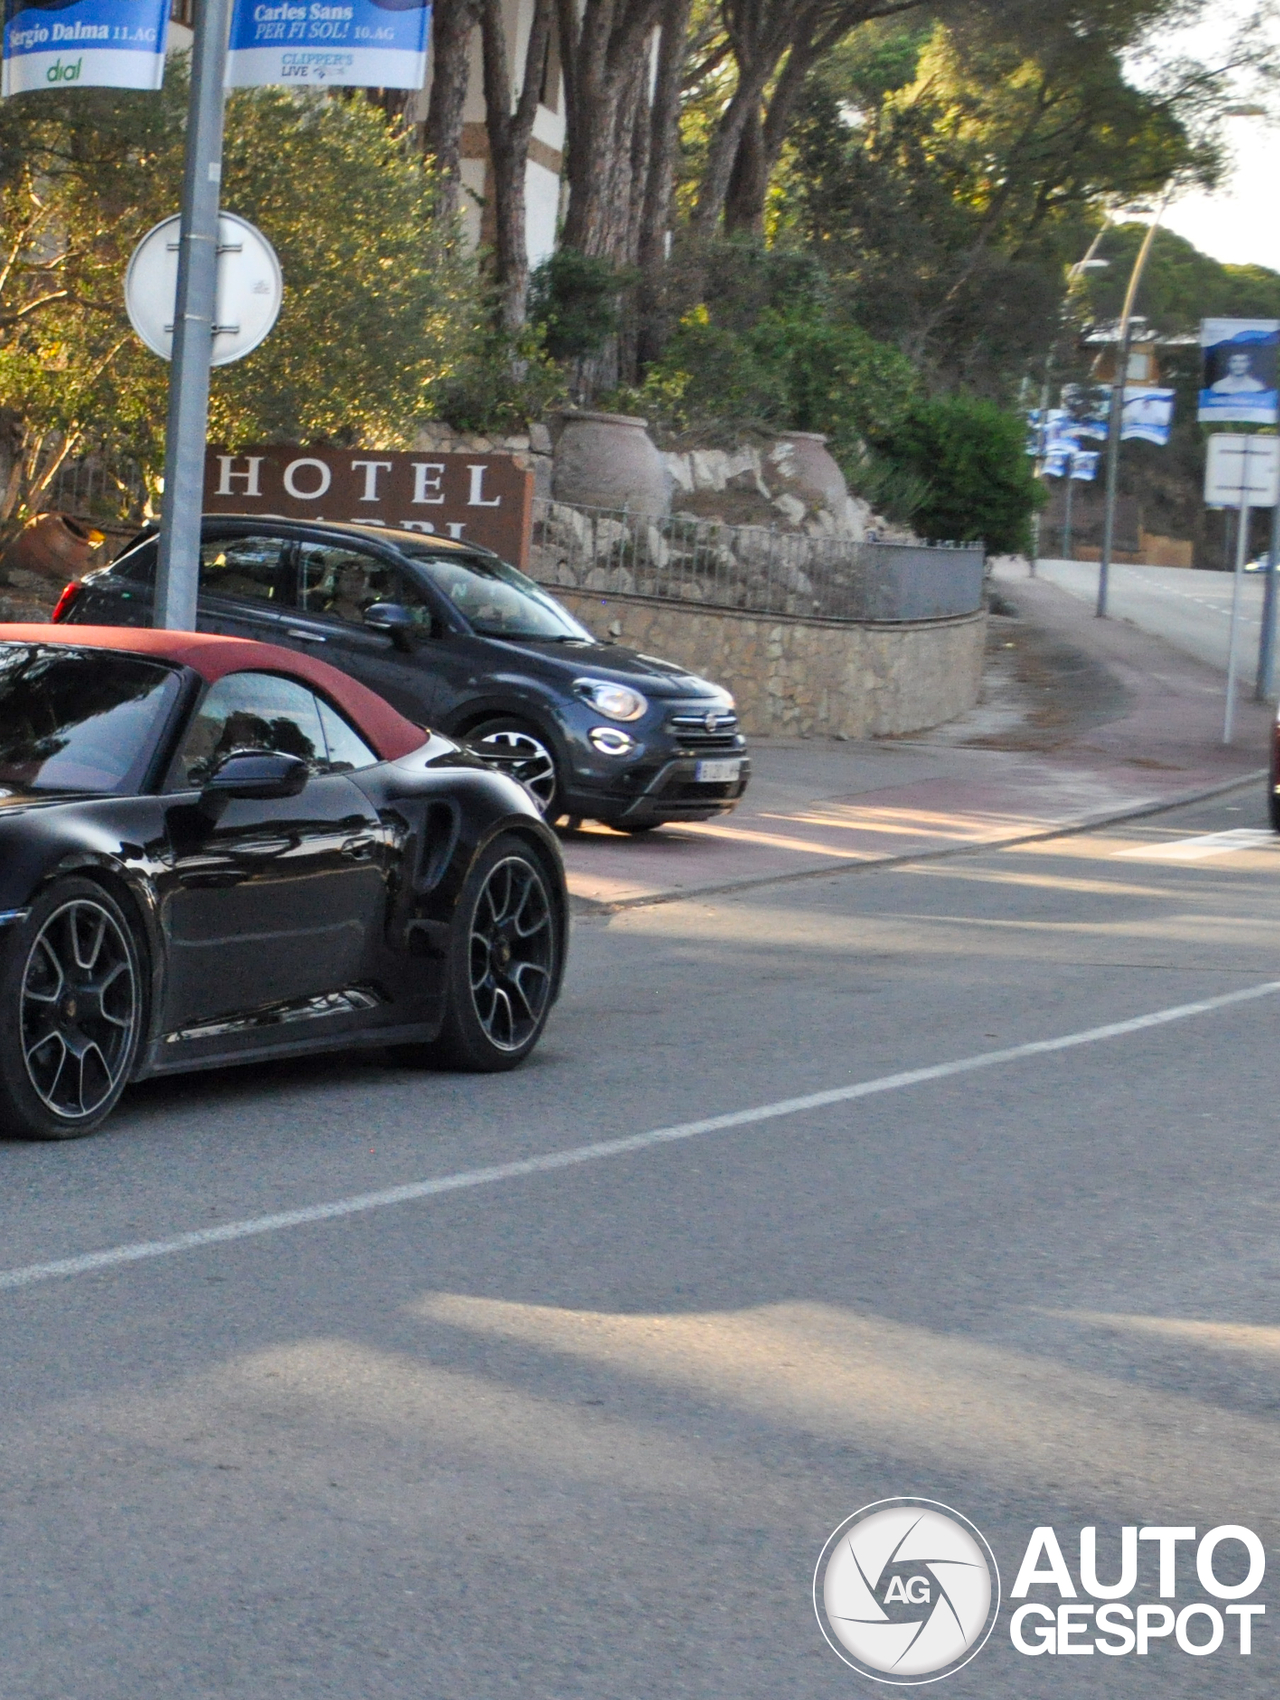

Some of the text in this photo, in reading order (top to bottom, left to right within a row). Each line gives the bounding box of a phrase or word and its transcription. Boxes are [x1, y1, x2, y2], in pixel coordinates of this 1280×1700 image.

[254, 4, 354, 22] Carles Sans
[51, 21, 110, 41] Dalma
[113, 27, 156, 42] 11.AG
[255, 22, 287, 40] PER
[287, 22, 306, 39] FI
[308, 21, 350, 39] SOL!
[46, 56, 82, 82] dial
[281, 66, 309, 77] LIVE
[214, 455, 501, 507] HOTEL
